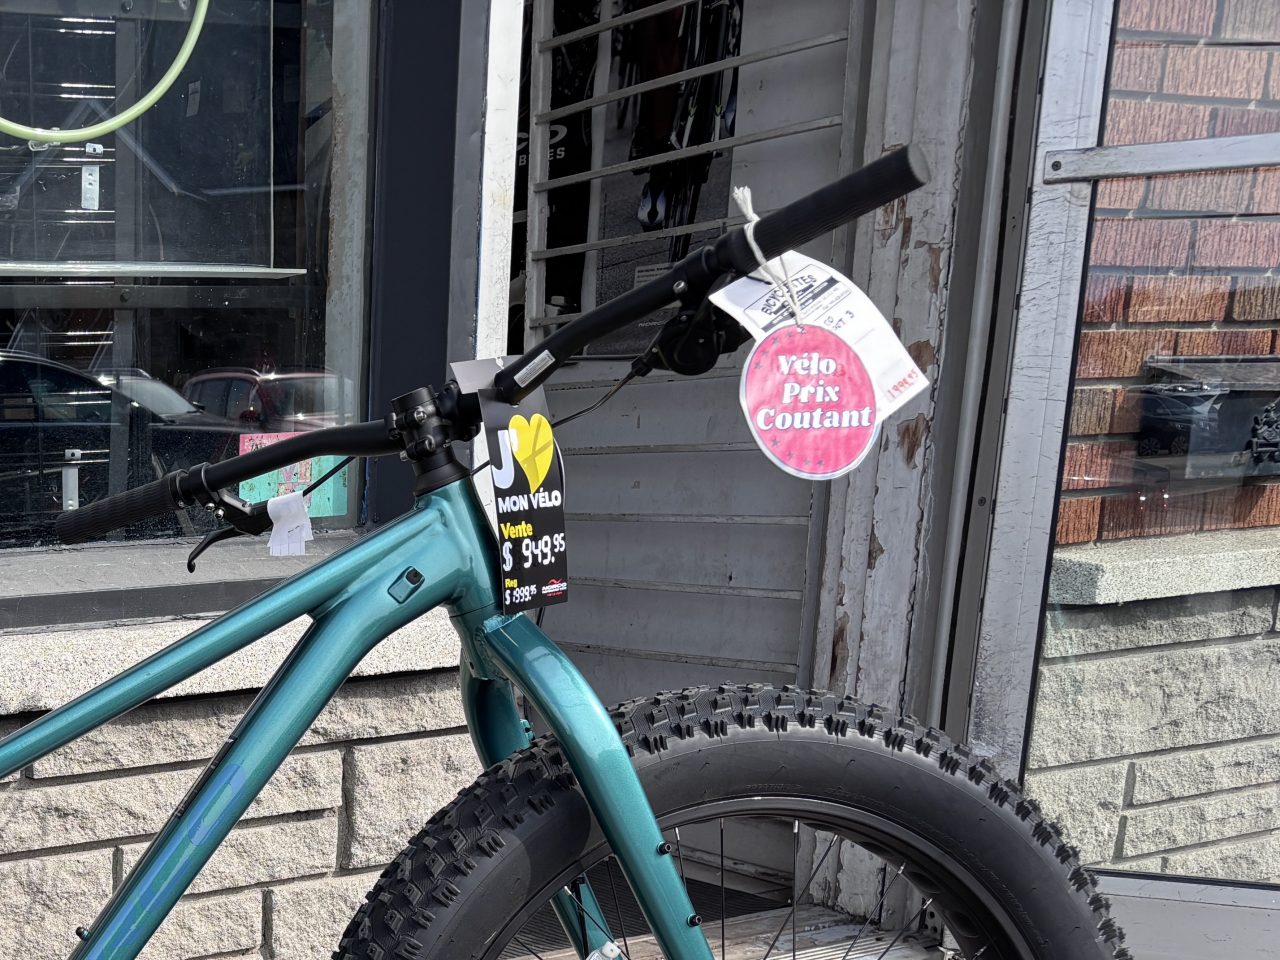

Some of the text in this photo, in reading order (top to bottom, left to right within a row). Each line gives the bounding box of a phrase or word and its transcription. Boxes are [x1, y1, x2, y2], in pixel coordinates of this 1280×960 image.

[777, 352, 837, 376] Vélo
[781, 379, 840, 405] Prix
[756, 406, 873, 431] Coutant
[497, 487, 562, 514] MON VÉLO
[500, 520, 533, 540] Vente
[504, 578, 518, 589] Reg
